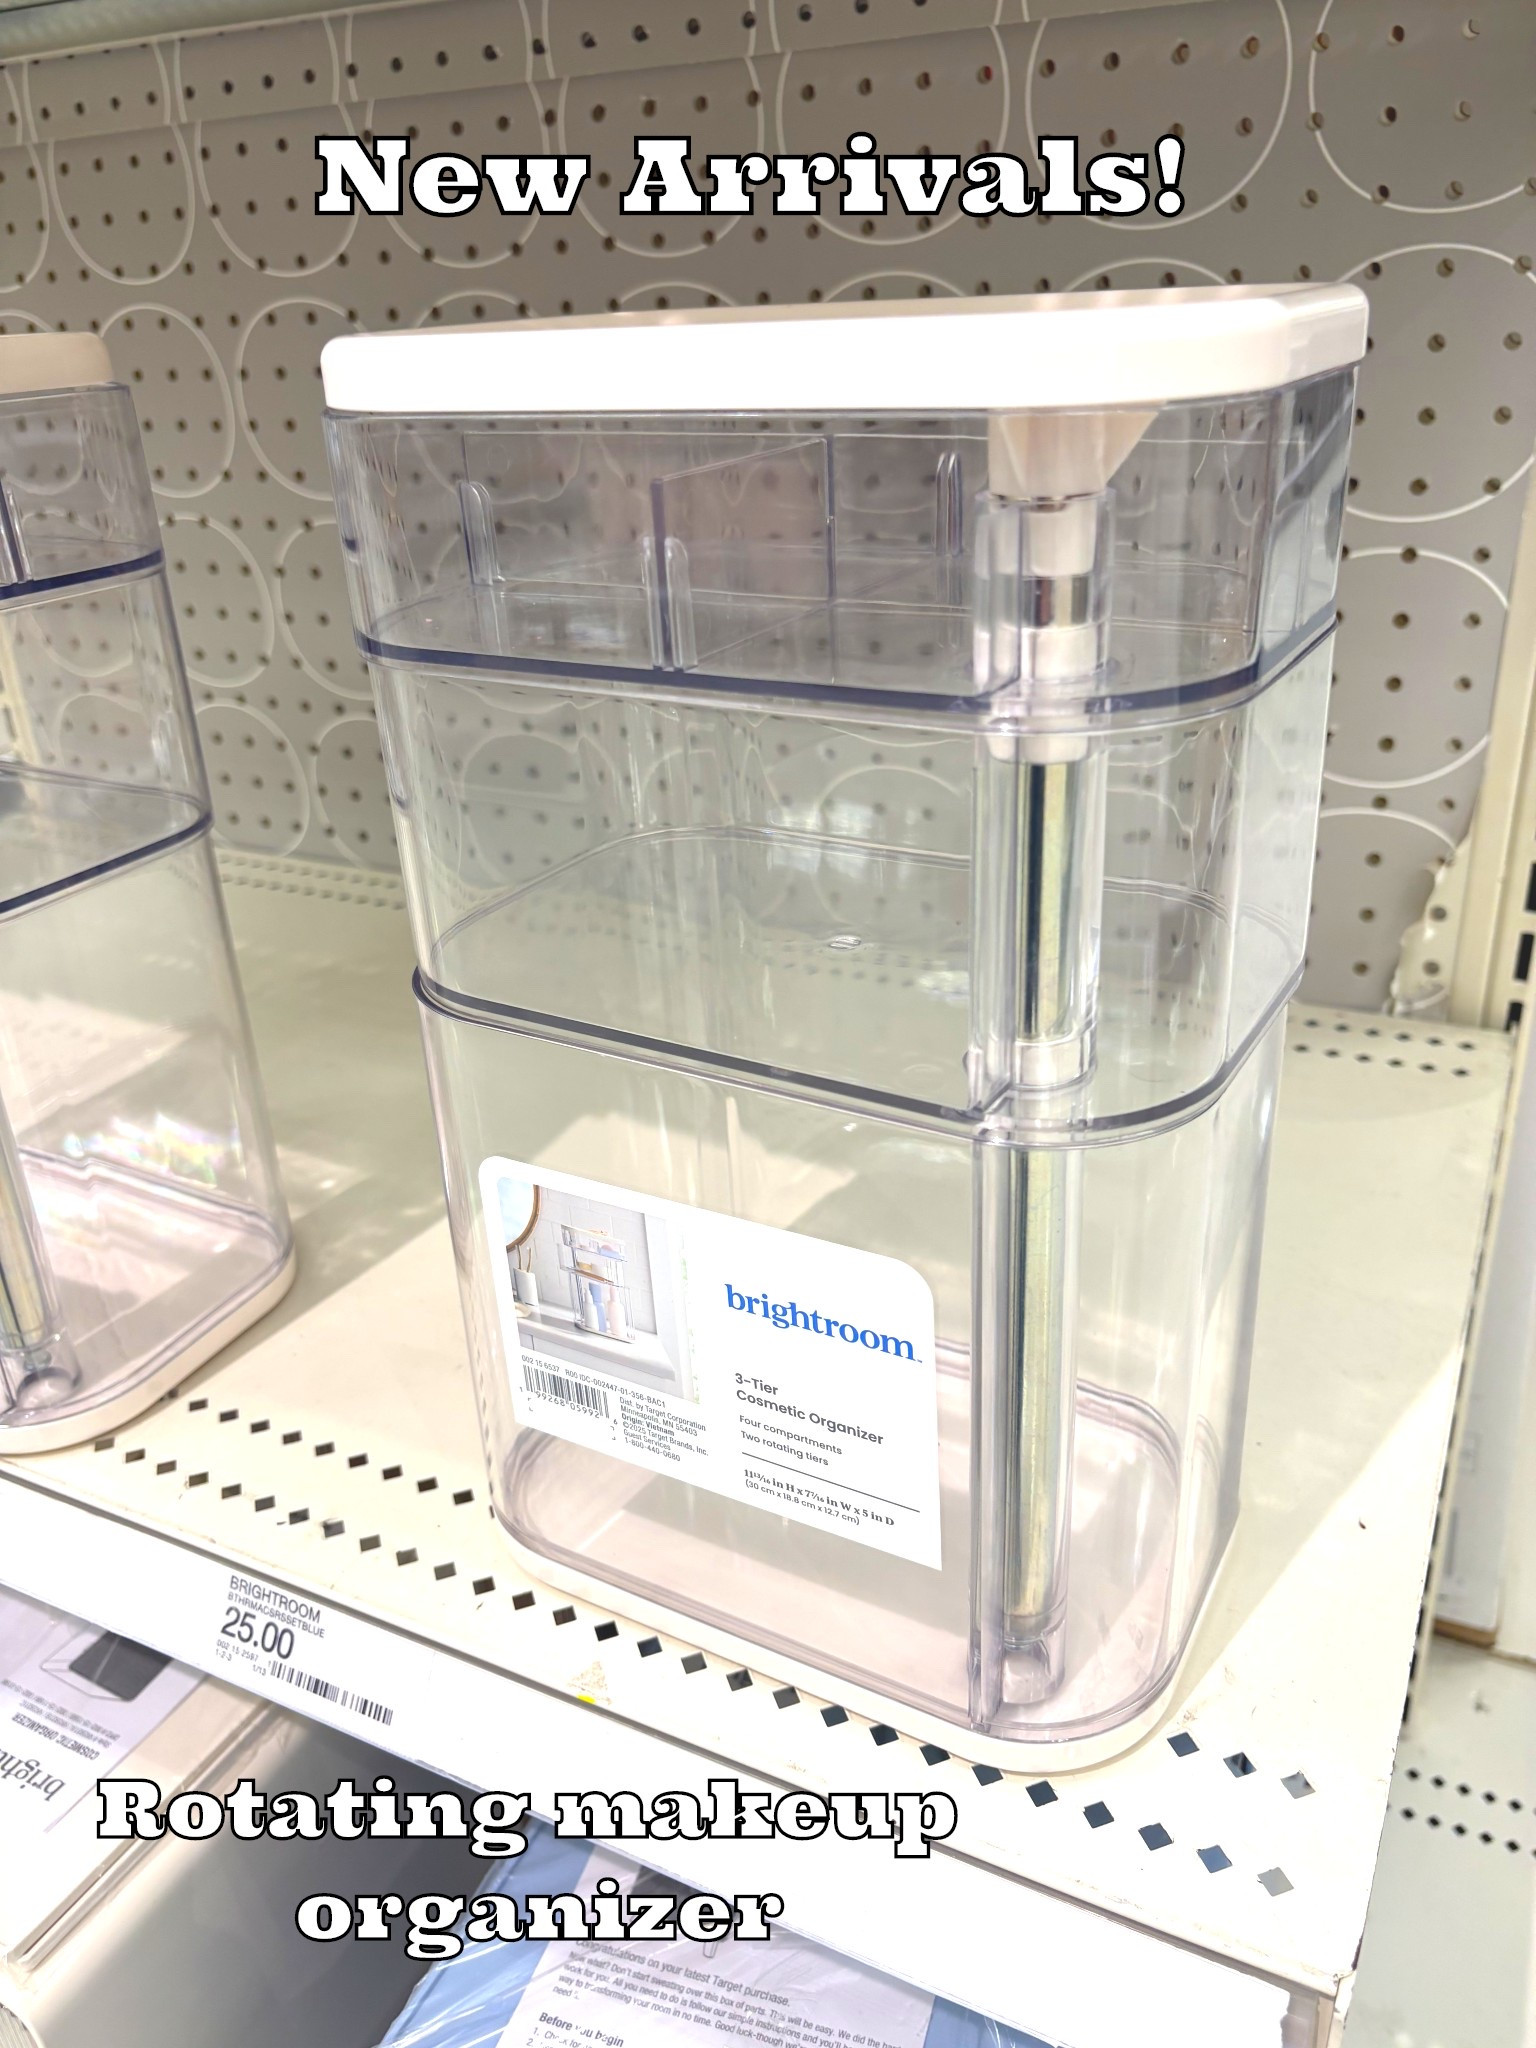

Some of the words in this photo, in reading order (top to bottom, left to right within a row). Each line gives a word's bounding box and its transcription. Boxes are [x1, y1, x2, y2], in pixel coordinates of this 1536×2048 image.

[725, 1283, 917, 1362] brightroom
[522, 1354, 534, 1364] 002
[544, 1362, 560, 1372] 6537
[735, 1373, 778, 1395] 3-Tier
[536, 1391, 566, 1407] 99268
[570, 1402, 600, 1418] 05992
[620, 1396, 634, 1408] Dist.
[636, 1402, 644, 1412] by
[645, 1405, 666, 1419] Target
[667, 1412, 706, 1432] Corporation
[736, 1390, 806, 1420] Cosmetic
[809, 1412, 884, 1445] Organizer
[622, 1412, 644, 1426] Origin:
[646, 1420, 674, 1437] Vietnam
[622, 1421, 646, 1434] ©2025
[648, 1428, 668, 1443] Target
[670, 1437, 695, 1452] Brands,
[696, 1446, 709, 1456] Inc.
[624, 1428, 642, 1440] Guest
[643, 1436, 671, 1450] Services
[662, 1418, 674, 1429] MN
[676, 1424, 698, 1437] 55403
[739, 1415, 761, 1428] Four
[764, 1424, 842, 1455] compartments
[625, 1437, 680, 1462] 1-800-440-0680
[741, 1430, 760, 1444] Two
[762, 1438, 804, 1460] rotating
[806, 1449, 828, 1466] tiers
[746, 1479, 759, 1491] (30
[760, 1484, 775, 1496] cm
[783, 1492, 800, 1504] 18.8
[802, 1500, 816, 1510] cm
[824, 1506, 840, 1518] 12.7
[842, 1514, 860, 1526] cm)
[772, 1478, 784, 1489] in
[786, 1483, 794, 1493] H
[796, 1488, 803, 1496] x
[826, 1496, 838, 1508] in
[840, 1500, 852, 1512] W
[854, 1507, 860, 1515] x
[862, 1509, 868, 1518] 5
[871, 1512, 882, 1522] in
[886, 1516, 894, 1526] D
[229, 1575, 321, 1624] BRIGHTROOM
[220, 1606, 295, 1660] 25.00
[12, 1712, 59, 1740] ORGANIZER
[56, 1735, 100, 1760] COSMETIC
[552, 1985, 572, 1997] need
[648, 1958, 660, 1968] on
[660, 1962, 682, 1974] your
[684, 1968, 710, 1984] latest
[712, 1974, 743, 1992] Target
[744, 1986, 790, 2007] purchase.
[558, 1974, 574, 1986] way
[576, 1979, 584, 1988] to
[633, 1998, 650, 2008] your
[650, 2002, 672, 2014] room
[672, 2008, 680, 2017] in
[681, 2012, 692, 2021] no
[694, 2014, 712, 2027] time.
[714, 2020, 736, 2034] Good
[736, 2028, 784, 2046] luck-though
[564, 1964, 582, 1975] work
[584, 1968, 596, 1978] for
[612, 1977, 623, 1987] All
[624, 1982, 638, 1992] you
[640, 1986, 659, 1998] need
[660, 1991, 668, 2000] to
[668, 1994, 680, 2004] do
[680, 1998, 688, 2006] is
[688, 2000, 712, 2014] follow
[713, 2008, 728, 2018] our
[728, 2012, 754, 2026] simple
[755, 2019, 801, 2039] instructions
[802, 2034, 818, 2045] and
[587, 1958, 611, 1970] what?
[610, 1963, 632, 1976] Don't
[632, 1970, 650, 1982] start
[650, 1976, 685, 1994] sweating
[686, 1986, 703, 1998] over
[704, 1991, 719, 2002] this
[720, 1995, 734, 2006] box
[736, 2000, 745, 2010] of
[788, 2016, 802, 2026] will
[802, 2020, 813, 2030] be
[815, 2024, 835, 2037] easy.
[838, 2028, 851, 2040] We
[852, 2034, 866, 2045] did
[868, 2038, 881, 2048] the
[533, 2026, 540, 2036] 1.
[538, 2012, 573, 2031] Before
